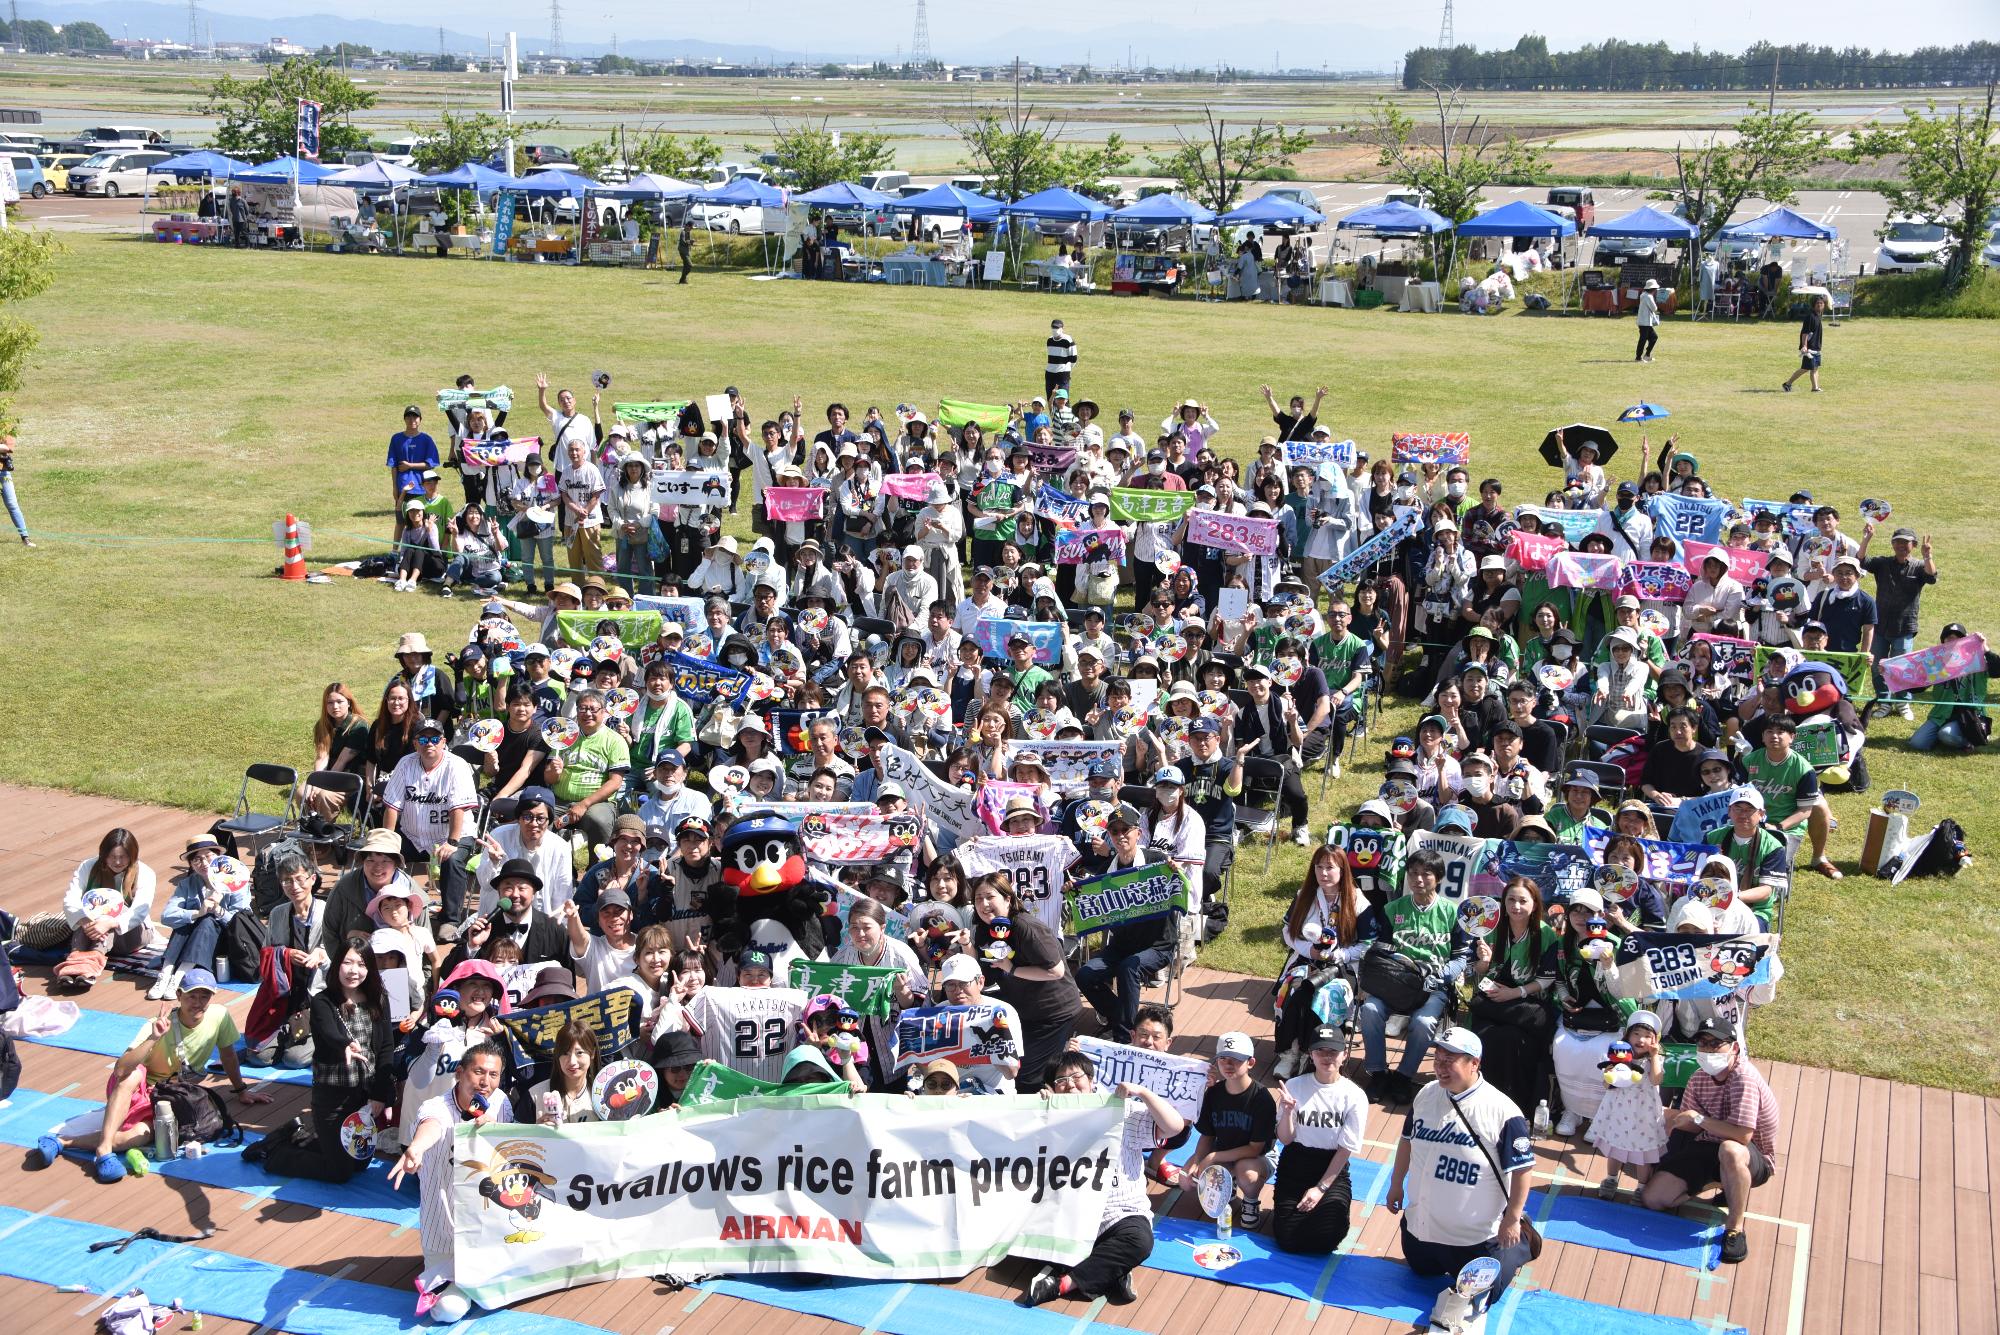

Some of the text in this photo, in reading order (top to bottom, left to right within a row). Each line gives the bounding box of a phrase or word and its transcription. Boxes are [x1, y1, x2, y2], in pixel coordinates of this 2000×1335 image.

[657, 482, 699, 494] ごいすー
[1120, 494, 1186, 513] 高津臣吾
[1674, 503, 1713, 515] TAKATSU
[1675, 512, 1706, 535] 22
[405, 786, 448, 805] Swallows
[429, 809, 449, 824] 22
[1691, 795, 1730, 819] TAKATS
[1000, 851, 1045, 863] TSUBAMI
[1419, 838, 1476, 860] SHIMOKAWA
[1567, 864, 1589, 879] 1st
[1076, 874, 1184, 920] 富山応燕会
[1393, 928, 1451, 949] Tokyo
[1646, 943, 1696, 974] 283
[1651, 970, 1703, 990] TSUBAMI
[735, 999, 787, 1015] TAKATSU
[967, 1005, 991, 1022] から
[734, 1017, 787, 1059] 22
[970, 1039, 1016, 1058] 来たちゃ
[1113, 1049, 1167, 1067] SPRING CAMP
[1411, 1118, 1479, 1149] Swallows
[567, 1145, 1110, 1211] Swallows rice farm project
[1435, 1154, 1481, 1186] 2896
[719, 1216, 862, 1246] AIRMAN
